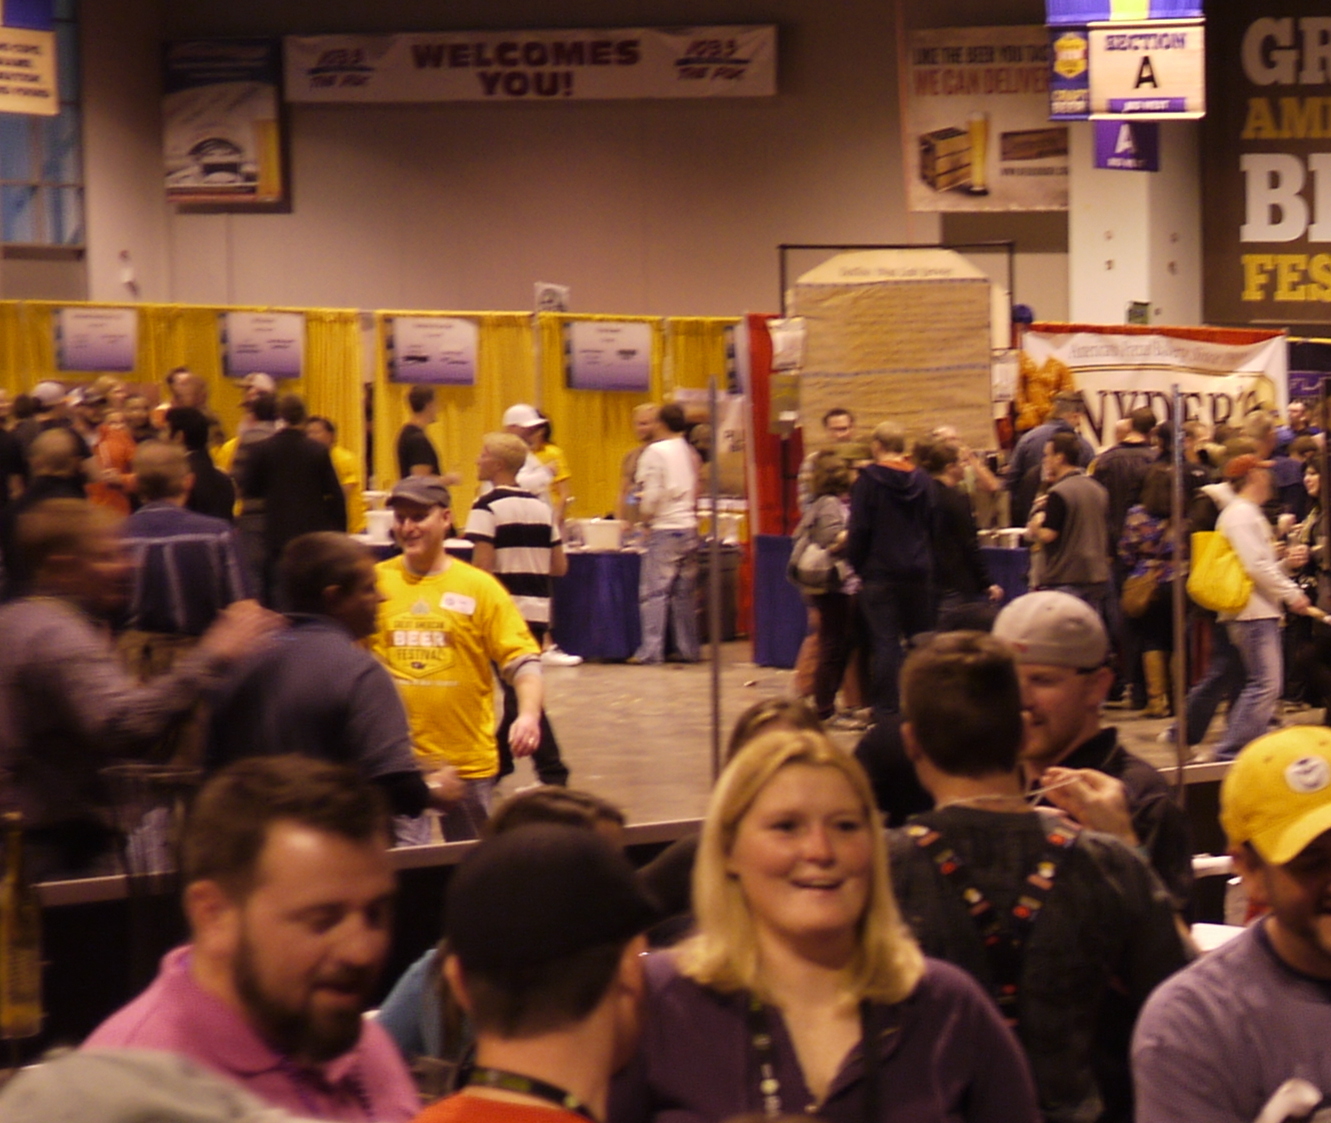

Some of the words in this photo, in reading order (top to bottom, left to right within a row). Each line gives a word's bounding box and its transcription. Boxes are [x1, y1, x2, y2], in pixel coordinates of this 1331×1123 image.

[411, 39, 641, 69] WELCOMES
[1104, 33, 1186, 52] SECTION
[477, 70, 574, 97] YOU!
[1133, 55, 1159, 89] A
[1114, 123, 1137, 154] A
[392, 630, 446, 646] BEER
[396, 648, 444, 661] FESTIVAL
